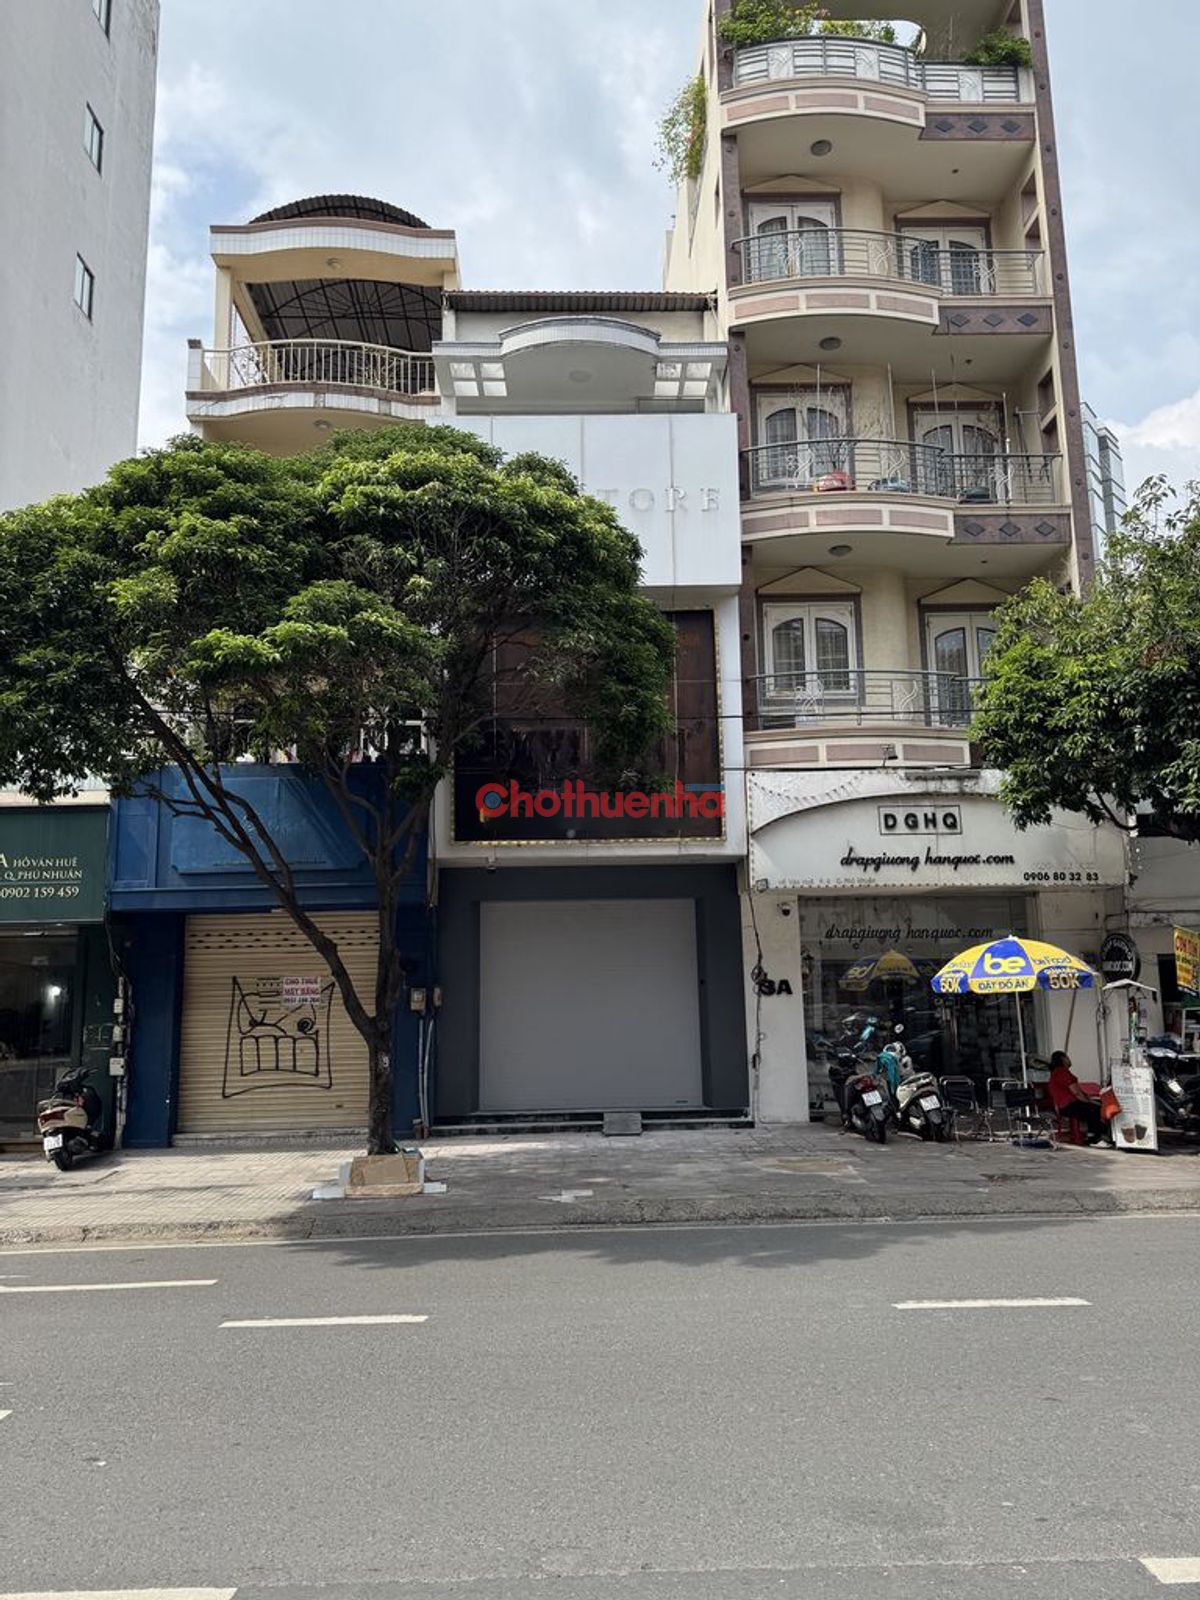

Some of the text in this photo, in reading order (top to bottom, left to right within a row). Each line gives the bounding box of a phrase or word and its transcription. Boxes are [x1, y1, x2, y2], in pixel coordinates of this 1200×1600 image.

[883, 812, 958, 830] DGHQ
[840, 846, 920, 872] drapgiuong
[1023, 871, 1099, 881] 0906 80 32 83
[33, 886, 56, 898] 159
[57, 886, 80, 898] 459
[825, 924, 902, 943] drapgiuong
[984, 953, 1026, 975] be
